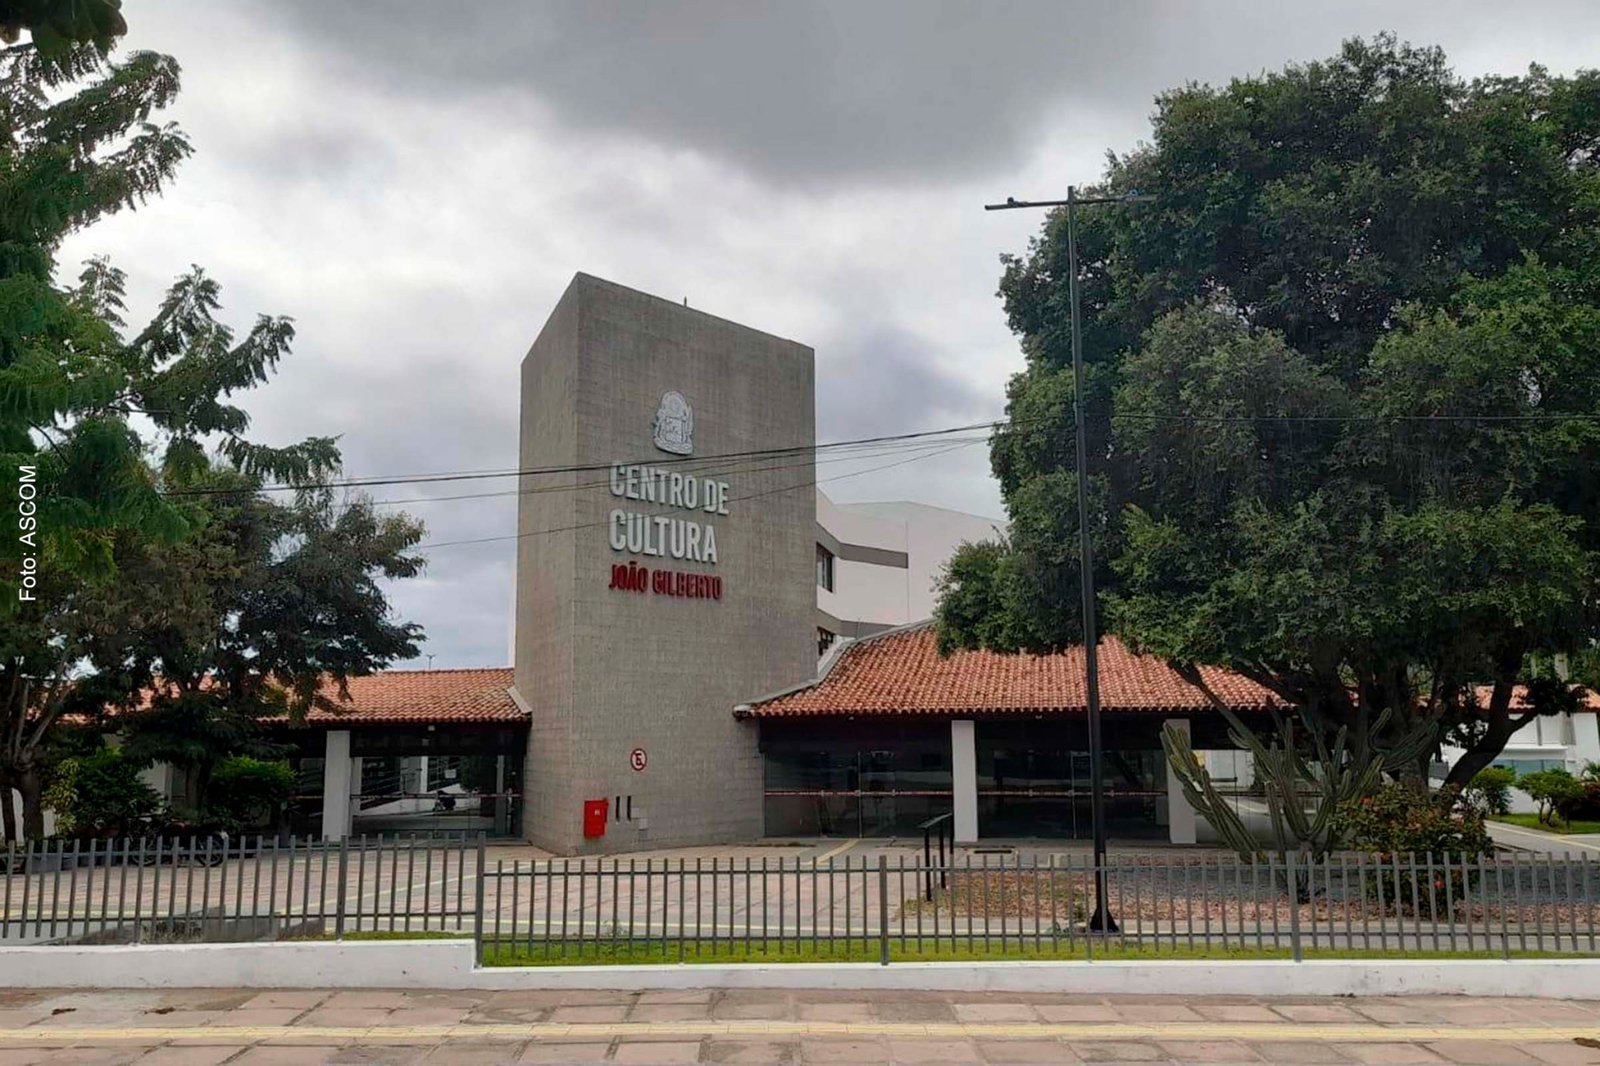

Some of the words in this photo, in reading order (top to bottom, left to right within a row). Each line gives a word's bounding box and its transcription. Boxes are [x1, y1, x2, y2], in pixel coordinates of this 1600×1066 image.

[609, 461, 698, 509] CENTRO
[703, 479, 729, 515] DE
[609, 509, 717, 564] CULTURA
[609, 561, 648, 592] JOÃO
[652, 570, 722, 599] GILBERTO
